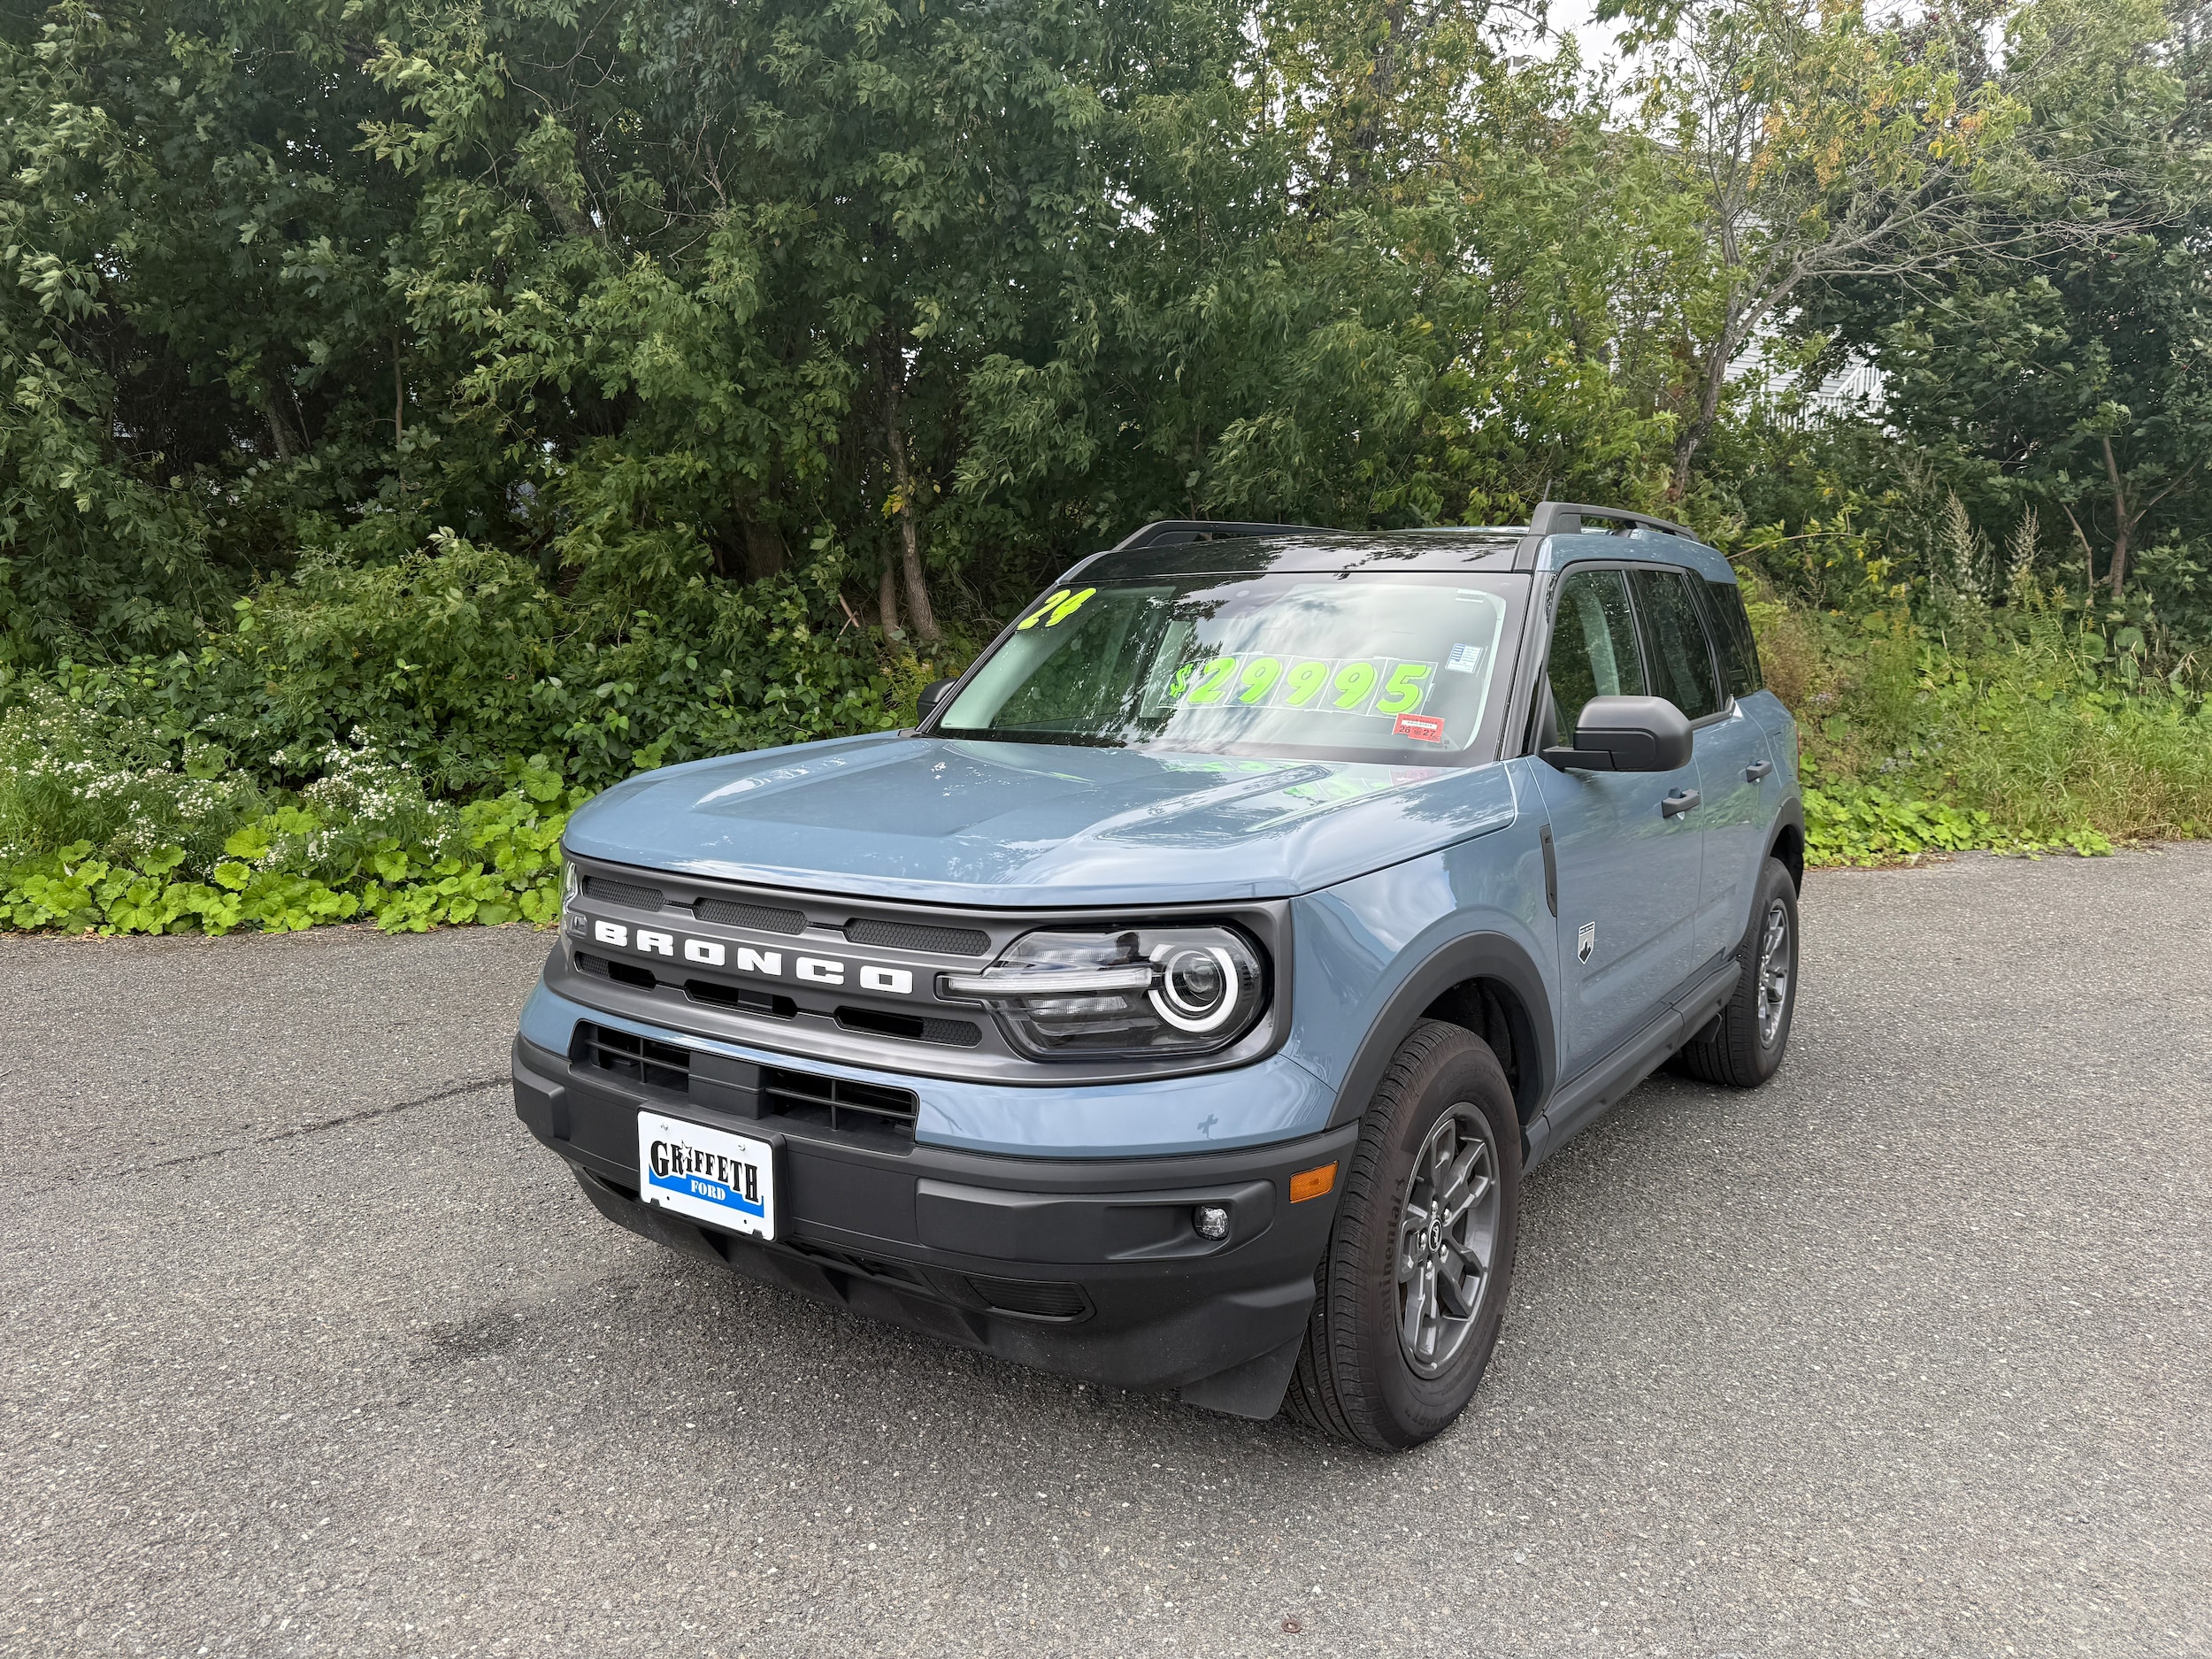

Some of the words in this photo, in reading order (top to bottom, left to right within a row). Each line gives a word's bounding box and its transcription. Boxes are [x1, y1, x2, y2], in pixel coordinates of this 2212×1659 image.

[1017, 588, 1097, 630] 24
[1168, 657, 1432, 715] $29995
[1423, 728, 1436, 737] 27
[595, 919, 913, 995] BRONCO
[650, 1140, 759, 1203] GRIFFETH
[690, 1179, 726, 1201] FORD
